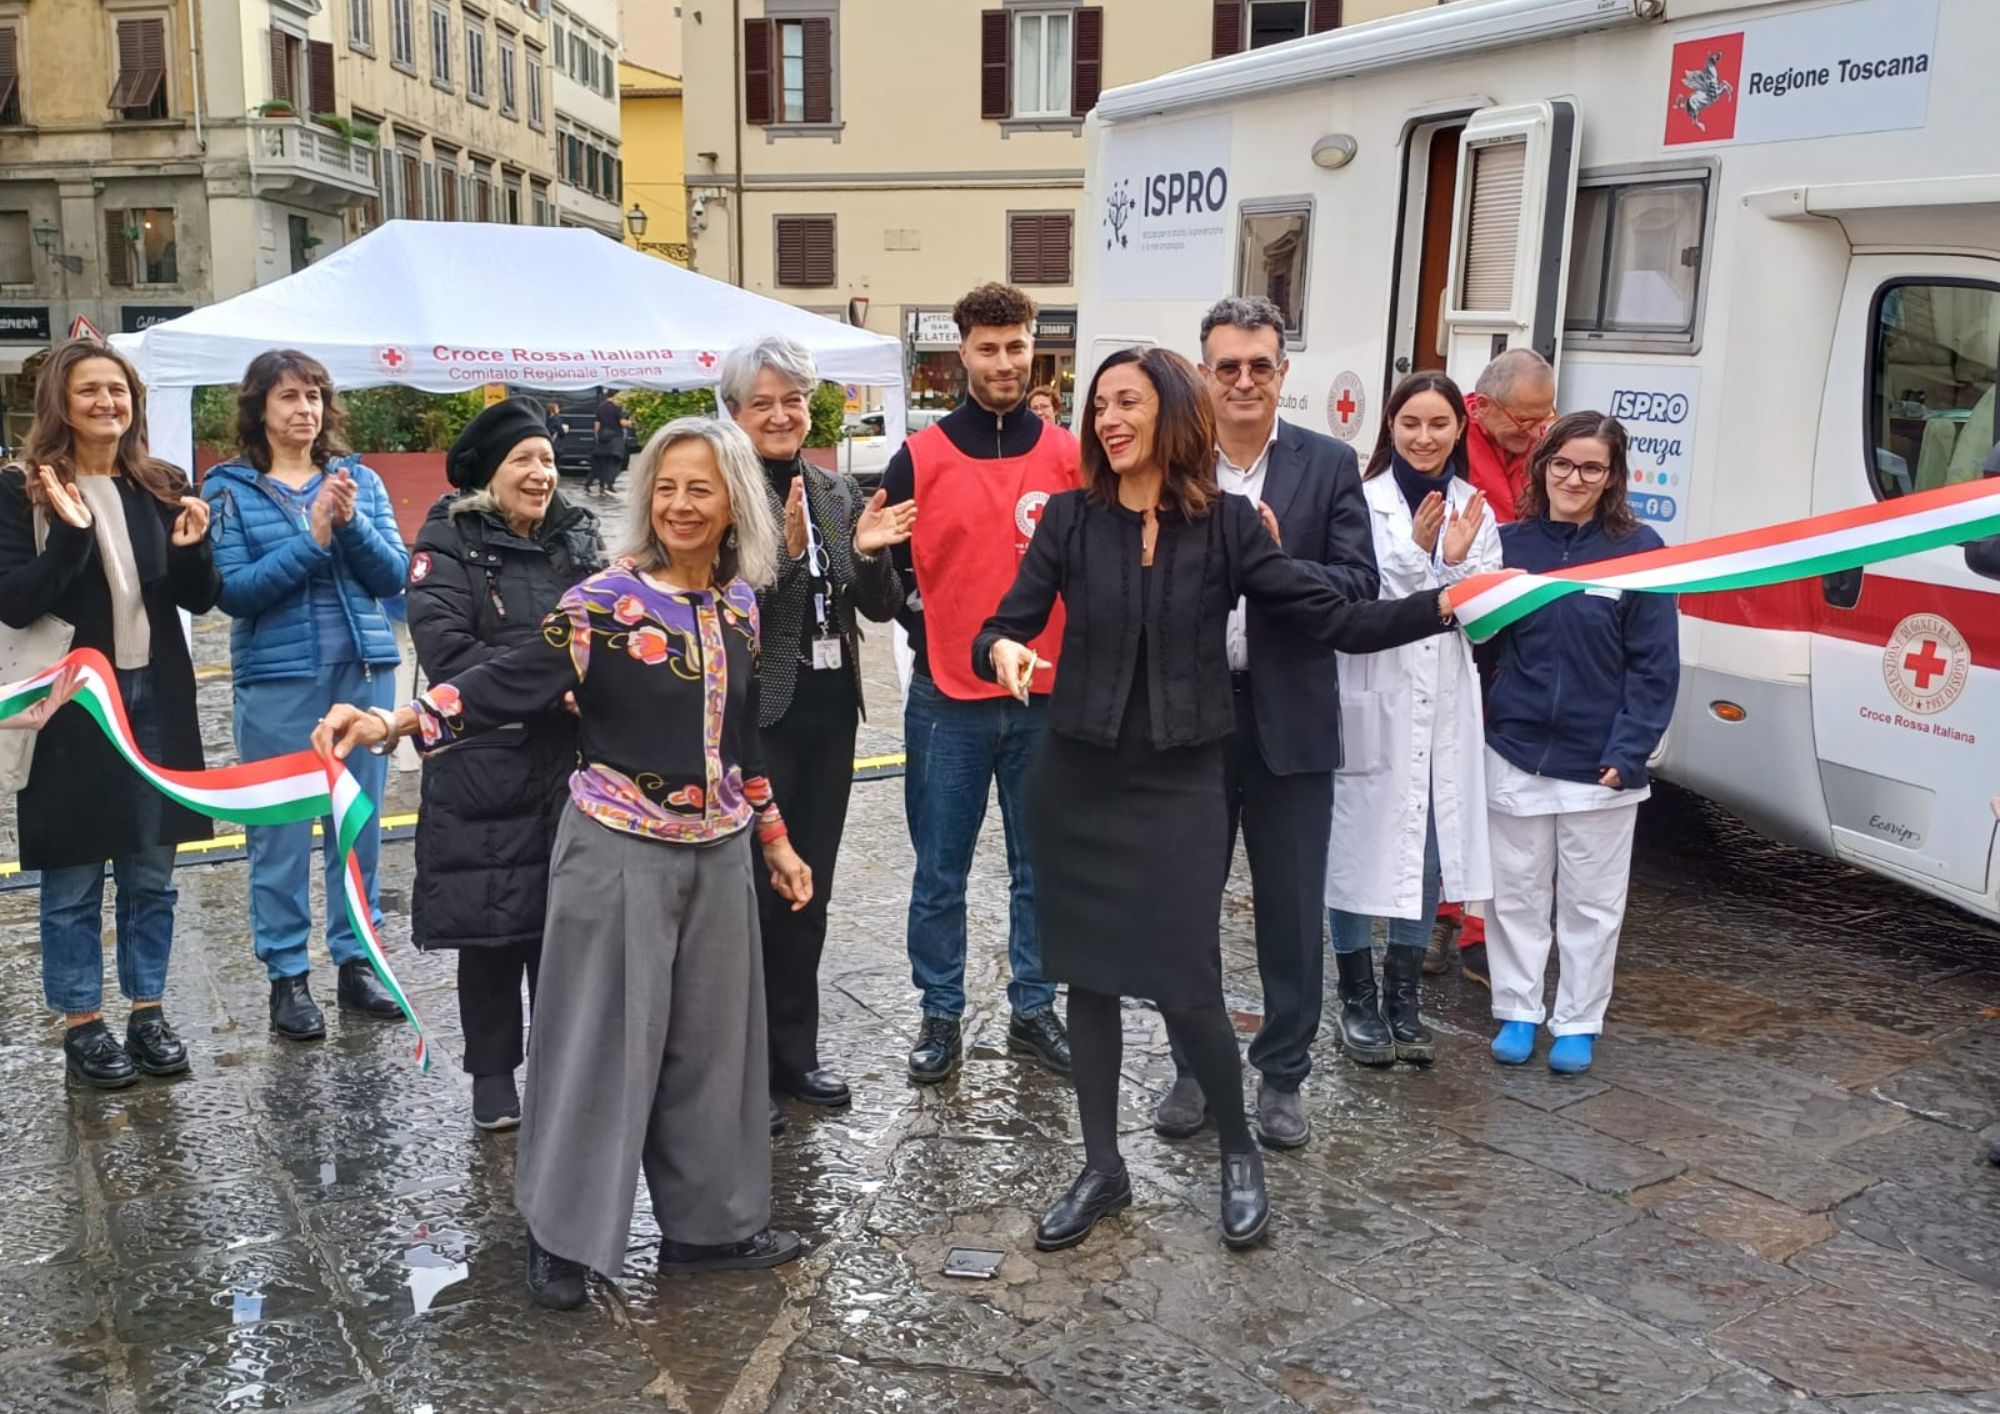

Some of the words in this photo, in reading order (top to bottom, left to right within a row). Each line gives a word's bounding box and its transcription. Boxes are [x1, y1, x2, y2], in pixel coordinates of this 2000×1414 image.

[1749, 67, 1829, 97] Regione
[1837, 53, 1929, 83] Toscana
[1144, 167, 1228, 217] ISPRO
[432, 344, 505, 362] Croce
[512, 347, 585, 362] Rossa
[591, 347, 674, 362] Italiana
[449, 366, 518, 381] Comitato
[523, 365, 598, 382] Regionale
[601, 364, 663, 379] Toscana
[1610, 390, 1688, 424] ISPRO
[1627, 434, 1683, 466] renza
[1859, 706, 1891, 724] Croce
[1894, 715, 1930, 734] Rossa
[1932, 723, 1976, 745] Italiana
